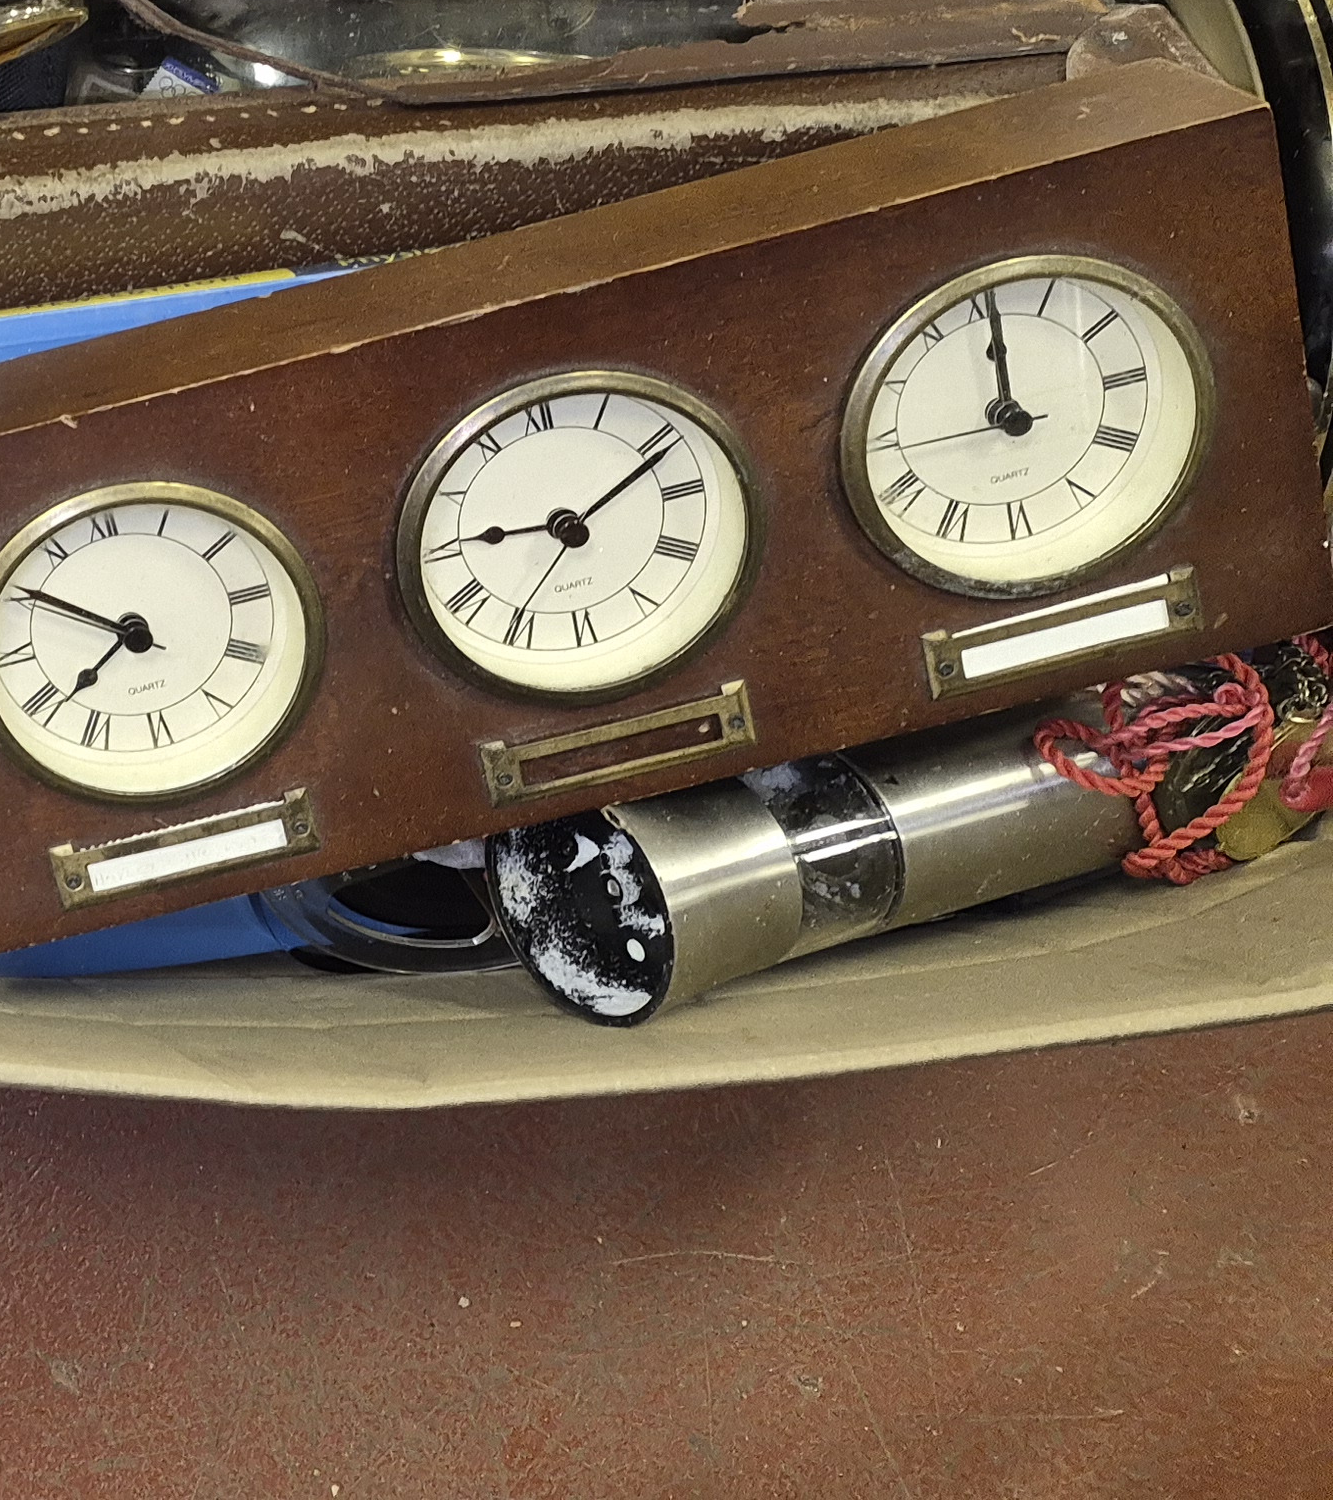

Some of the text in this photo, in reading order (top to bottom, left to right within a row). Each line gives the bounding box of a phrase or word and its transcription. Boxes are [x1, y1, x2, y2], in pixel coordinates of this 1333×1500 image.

[989, 467, 1030, 485] QUARTZ
[554, 577, 594, 593] QUARTZ
[127, 679, 167, 696] QUARTZ
